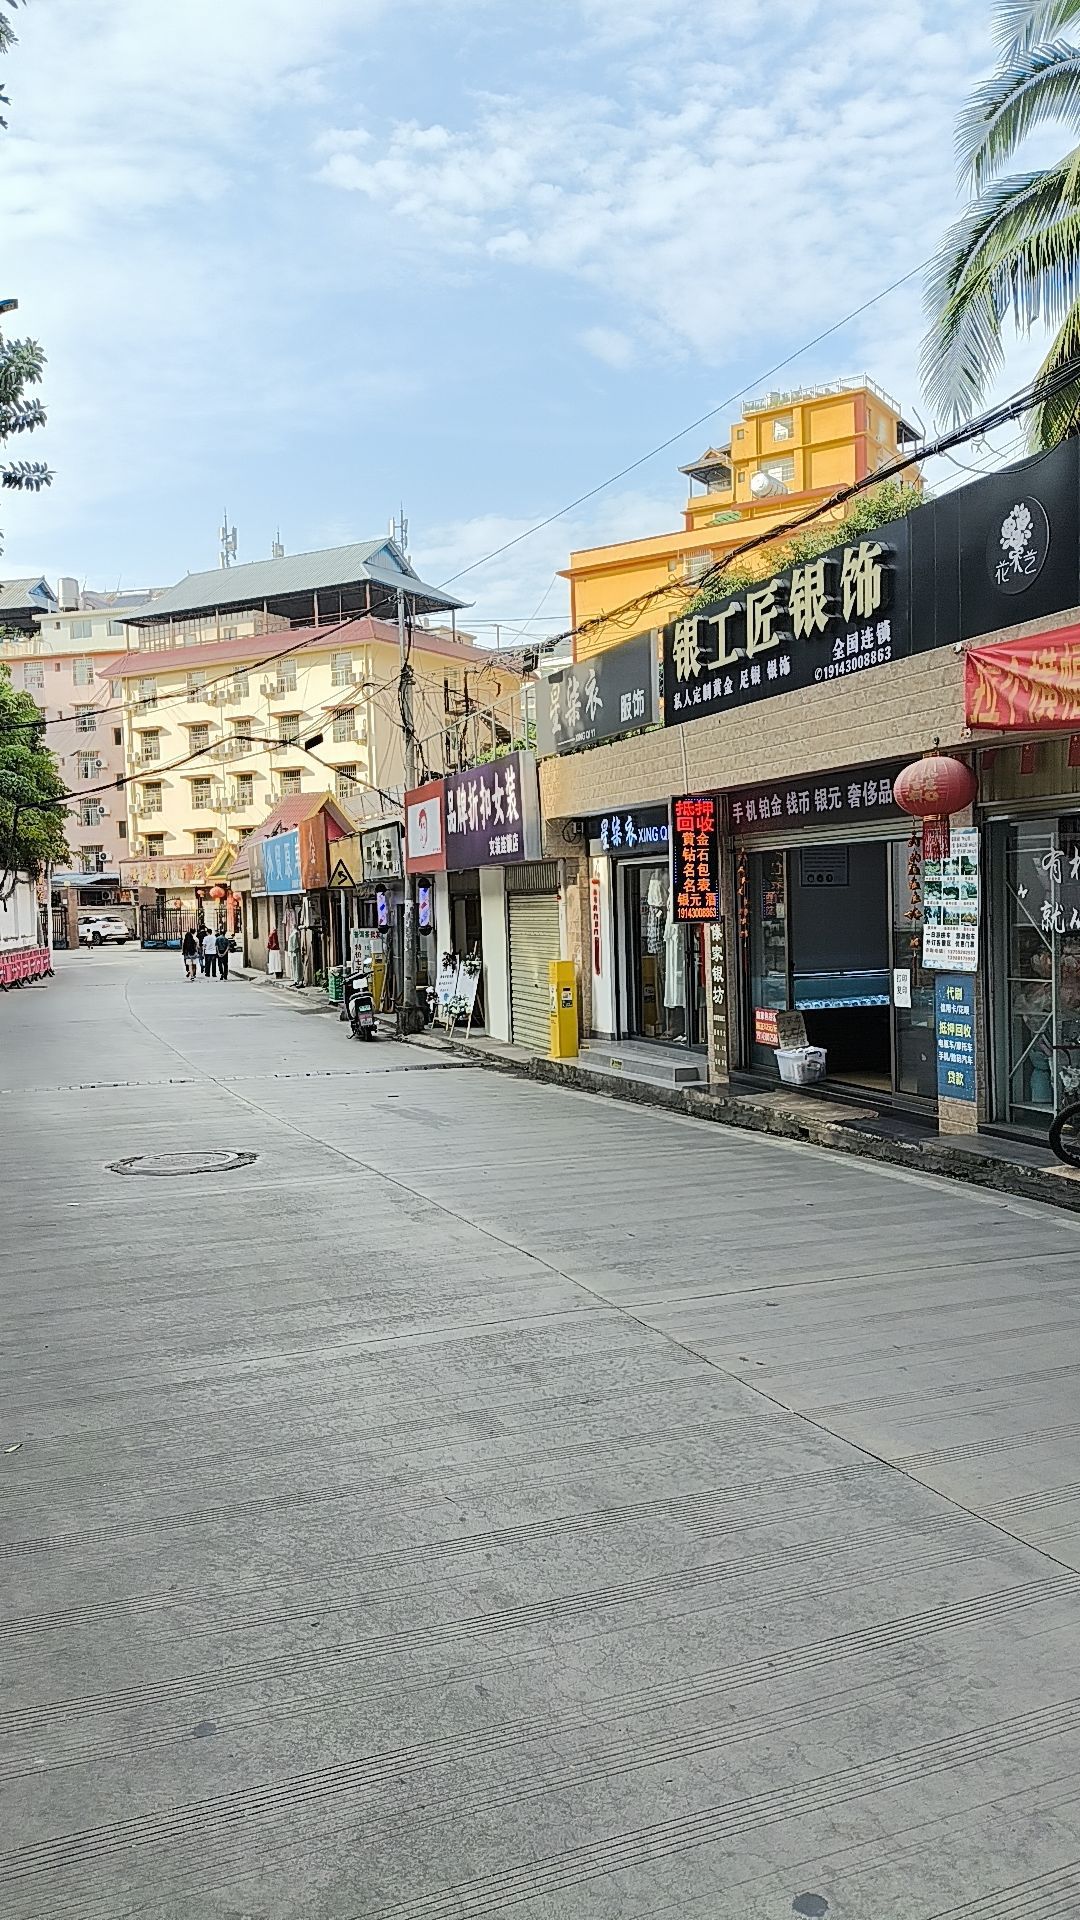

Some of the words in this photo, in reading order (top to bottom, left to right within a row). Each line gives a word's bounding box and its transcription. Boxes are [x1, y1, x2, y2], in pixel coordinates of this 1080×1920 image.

[673, 541, 884, 682] 银工匠银饰
[832, 619, 892, 661] 全国连锁
[823, 645, 892, 680] 19143008863
[673, 676, 734, 711] 私人定制黄金
[739, 665, 761, 690] 足银
[766, 655, 791, 681] 银饰
[620, 688, 645, 722] 服饰
[447, 764, 520, 836] 品牌折扣女装
[786, 790, 810, 816] 钱币
[814, 786, 842, 811] 银元
[847, 778, 893, 809] 奢侈品
[676, 801, 714, 817] 抵押
[676, 816, 714, 832] 回收
[637, 826, 659, 844] XING
[682, 832, 710, 847] 黄金
[682, 847, 710, 862] 钻石
[682, 862, 711, 878] 名包
[682, 878, 711, 893] 名表
[677, 893, 702, 907] 银元
[705, 893, 718, 907] 酒
[896, 973, 908, 983] 打印
[946, 985, 963, 1001] 代刷
[939, 1020, 972, 1038] 抵押回收
[947, 1070, 964, 1086] 贷款
